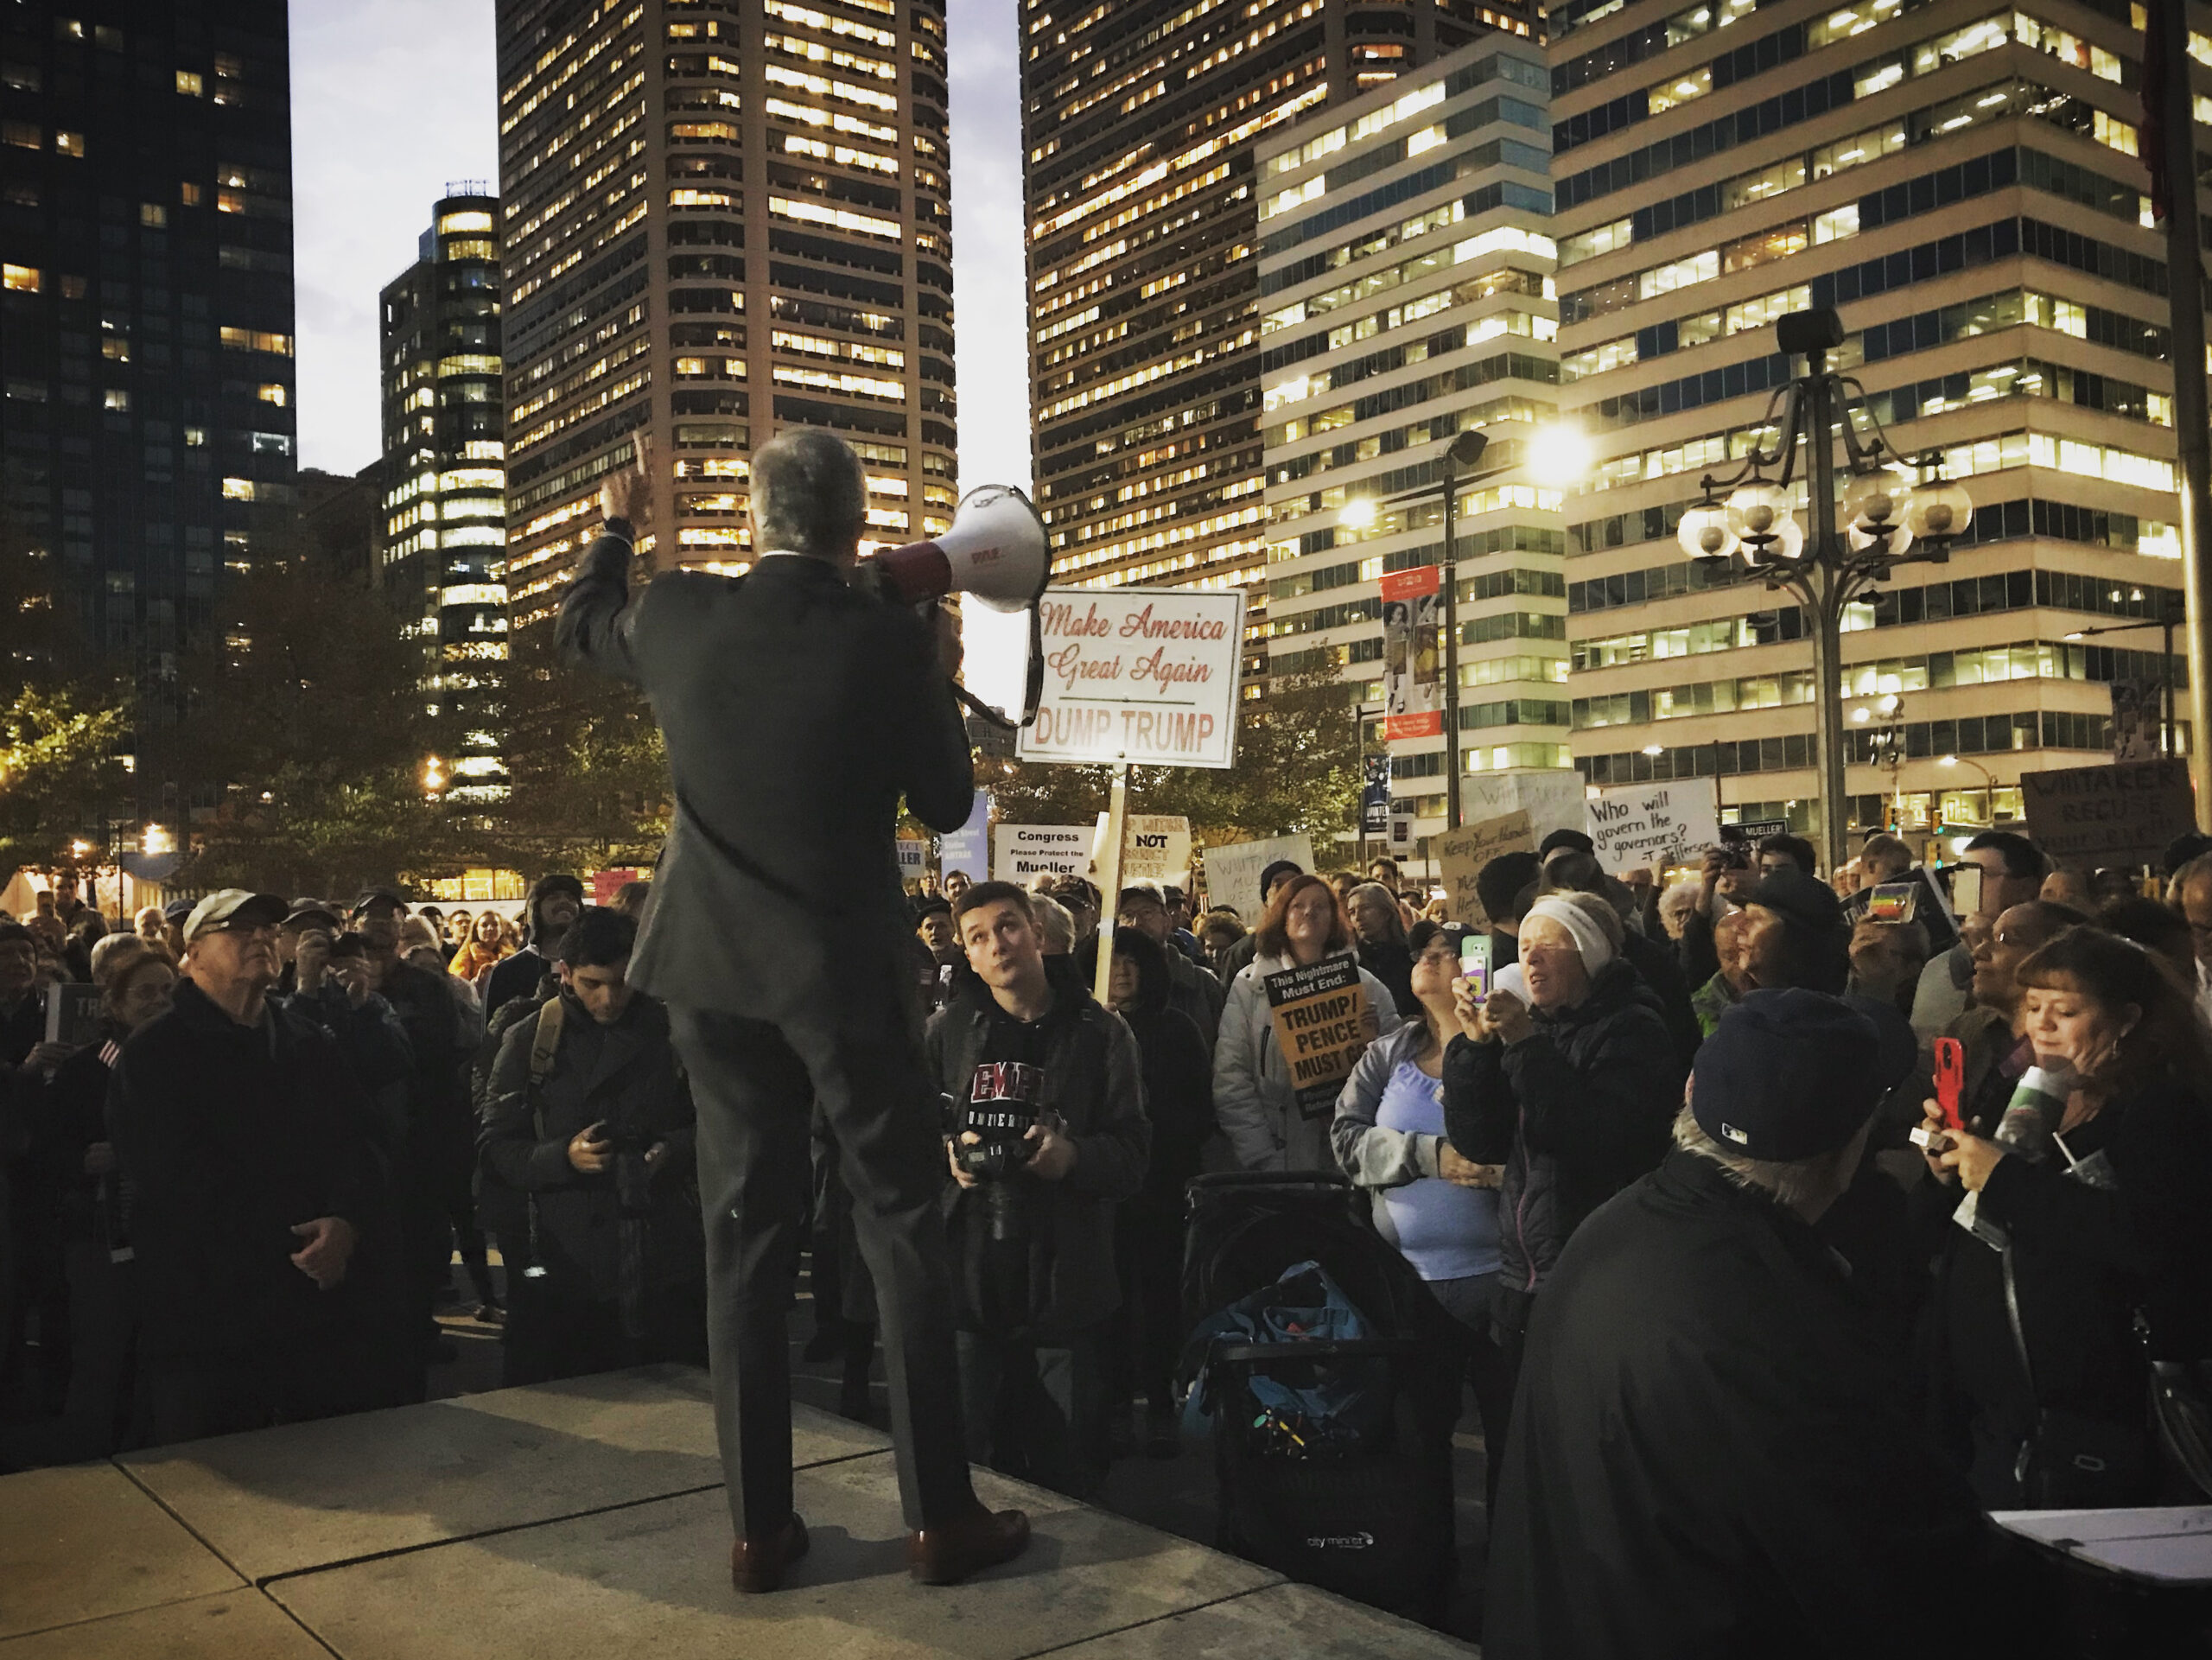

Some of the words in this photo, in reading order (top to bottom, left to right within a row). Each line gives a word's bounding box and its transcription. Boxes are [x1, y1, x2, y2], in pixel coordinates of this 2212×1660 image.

[1039, 601, 1113, 639] Make
[1119, 602, 1228, 641] America
[1047, 643, 1123, 691] Great
[1129, 646, 1213, 695] Again
[1034, 707, 1112, 746] DUMP
[1121, 710, 1215, 754] TRUMP
[1590, 799, 1629, 823] Who
[1642, 791, 1669, 812] will
[1017, 830, 1079, 843] Congress
[1136, 834, 1168, 849] NOT
[1597, 821, 1645, 851] govern
[1650, 812, 1670, 830] the
[1613, 824, 1688, 862] governors?
[1016, 861, 1076, 874] Mueller
[1270, 974, 1294, 989] This
[1295, 959, 1350, 983] Nightmare
[1281, 984, 1316, 1000] Must
[1319, 974, 1347, 990] End:
[1281, 992, 1357, 1032] TRUMP/
[1294, 1019, 1362, 1054] PENCE
[1294, 1048, 1344, 1082] MUST
